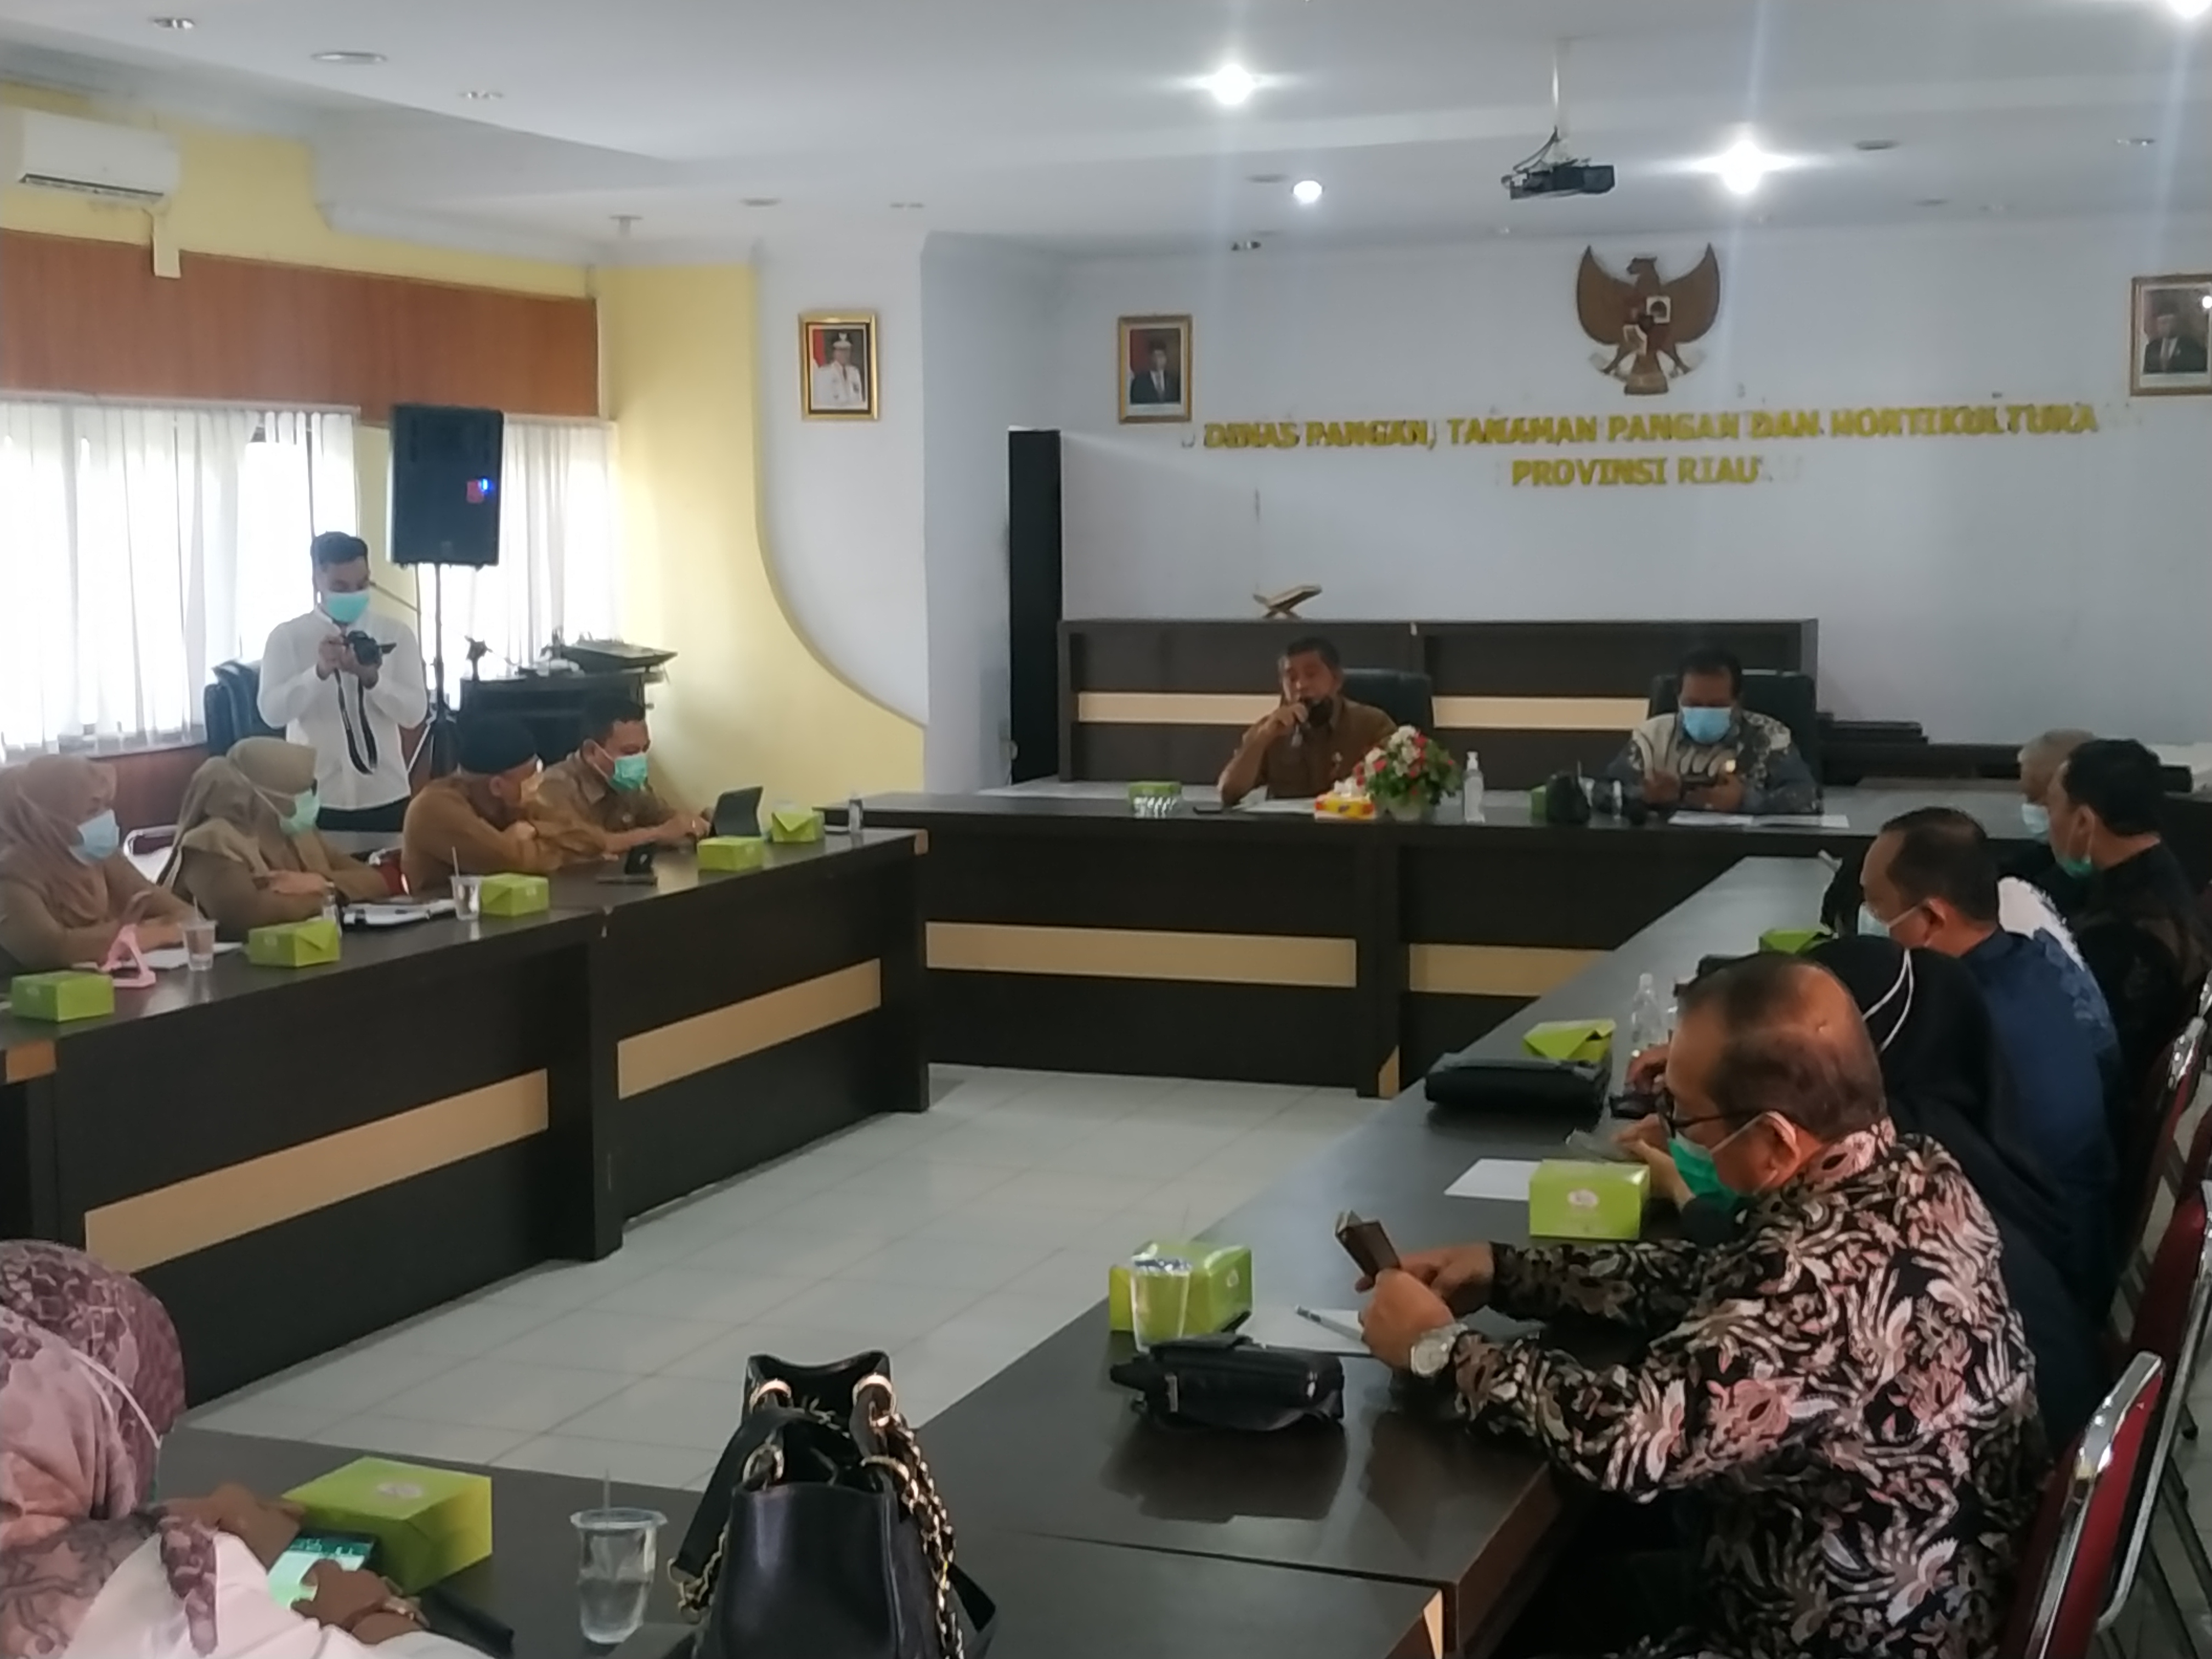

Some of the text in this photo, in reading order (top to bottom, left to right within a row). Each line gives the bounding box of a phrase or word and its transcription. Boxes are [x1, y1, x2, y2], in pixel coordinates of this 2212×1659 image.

[1607, 414, 1739, 441] PANGAN
[1751, 410, 1819, 437] DAN
[1512, 456, 1760, 486] PROVINSI RIAU
